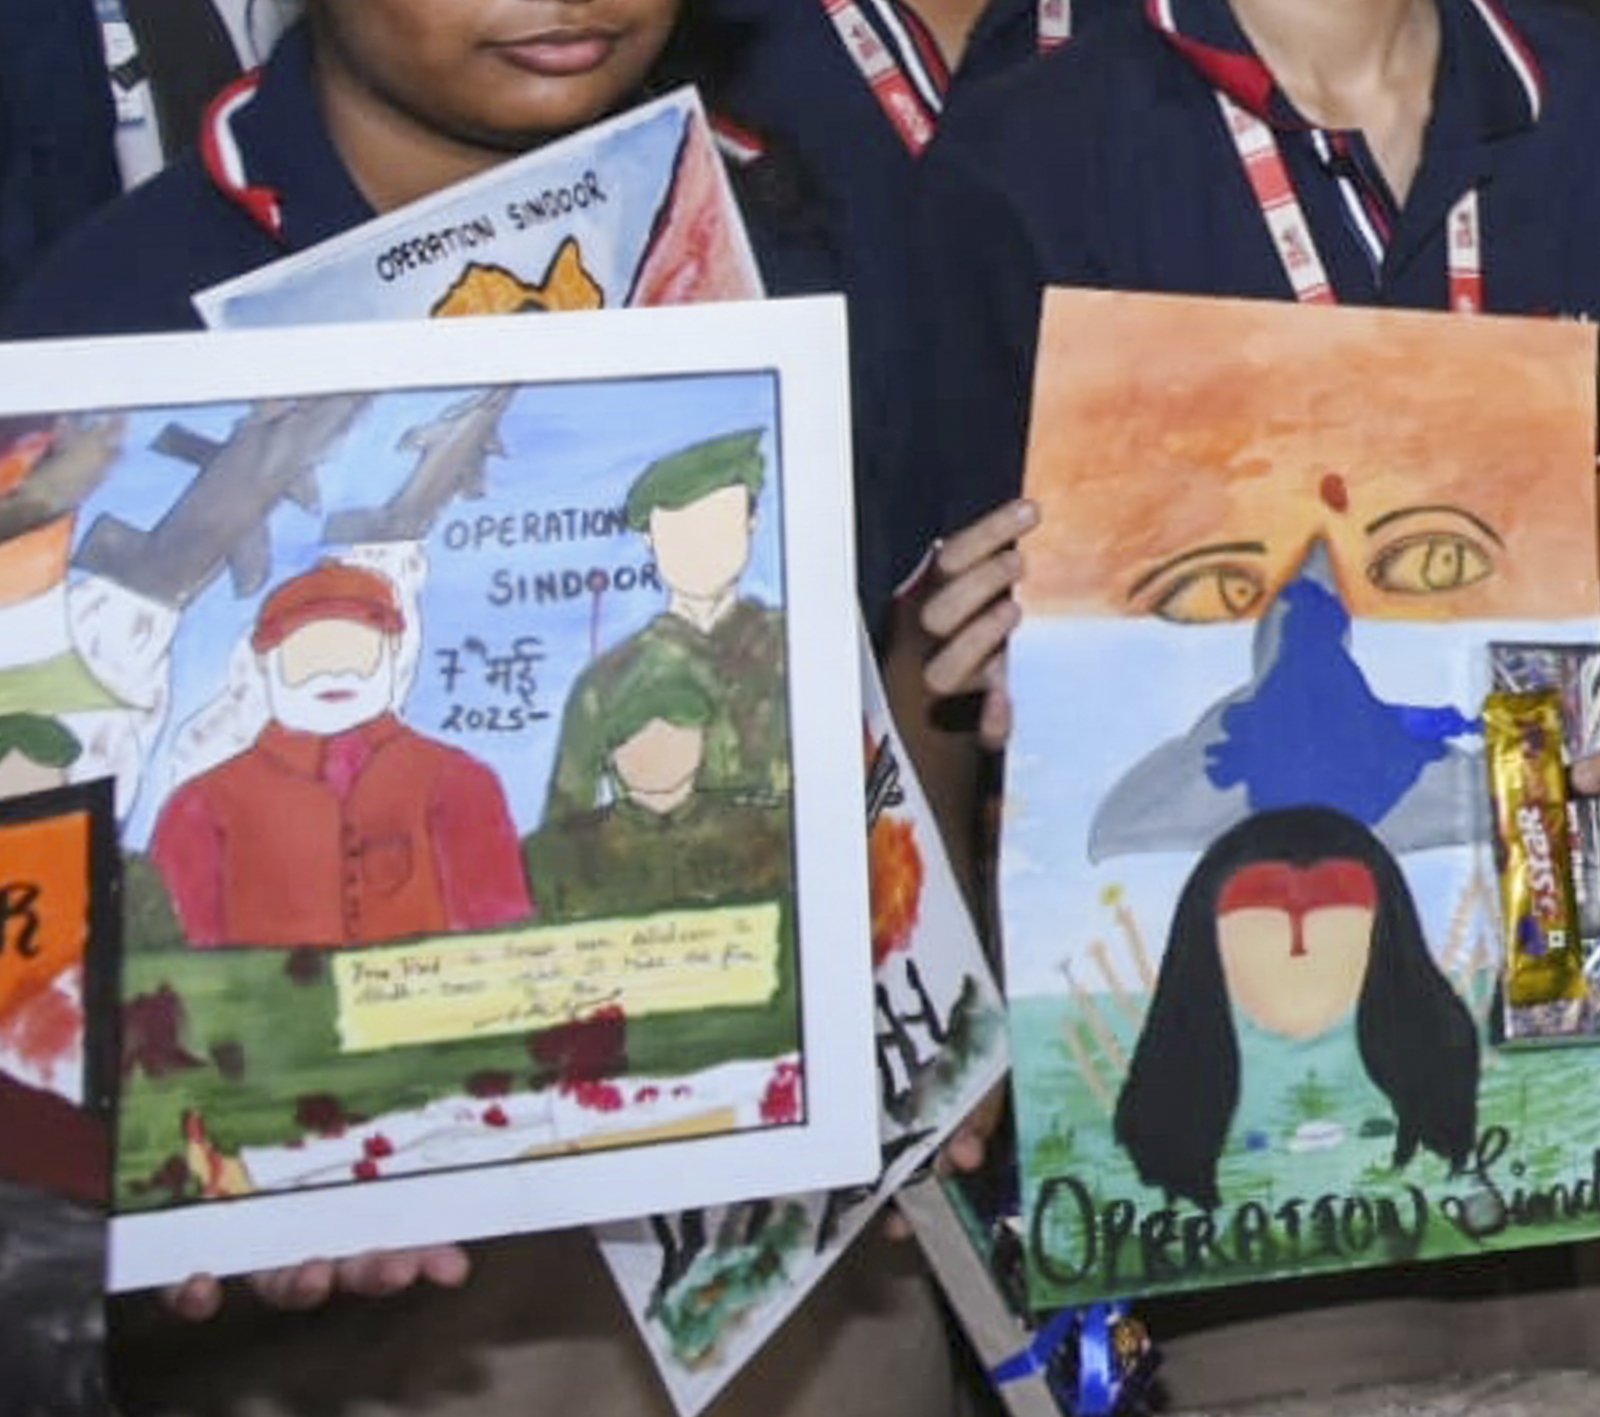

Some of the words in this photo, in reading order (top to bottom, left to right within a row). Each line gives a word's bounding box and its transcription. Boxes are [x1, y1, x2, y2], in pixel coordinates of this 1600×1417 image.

[376, 215, 496, 283] OPERATION
[506, 169, 608, 231] SINDOOR
[443, 504, 630, 552] OPERATION
[486, 563, 663, 606] SINDOOR
[1030, 1175, 1428, 1285] OPERATION
